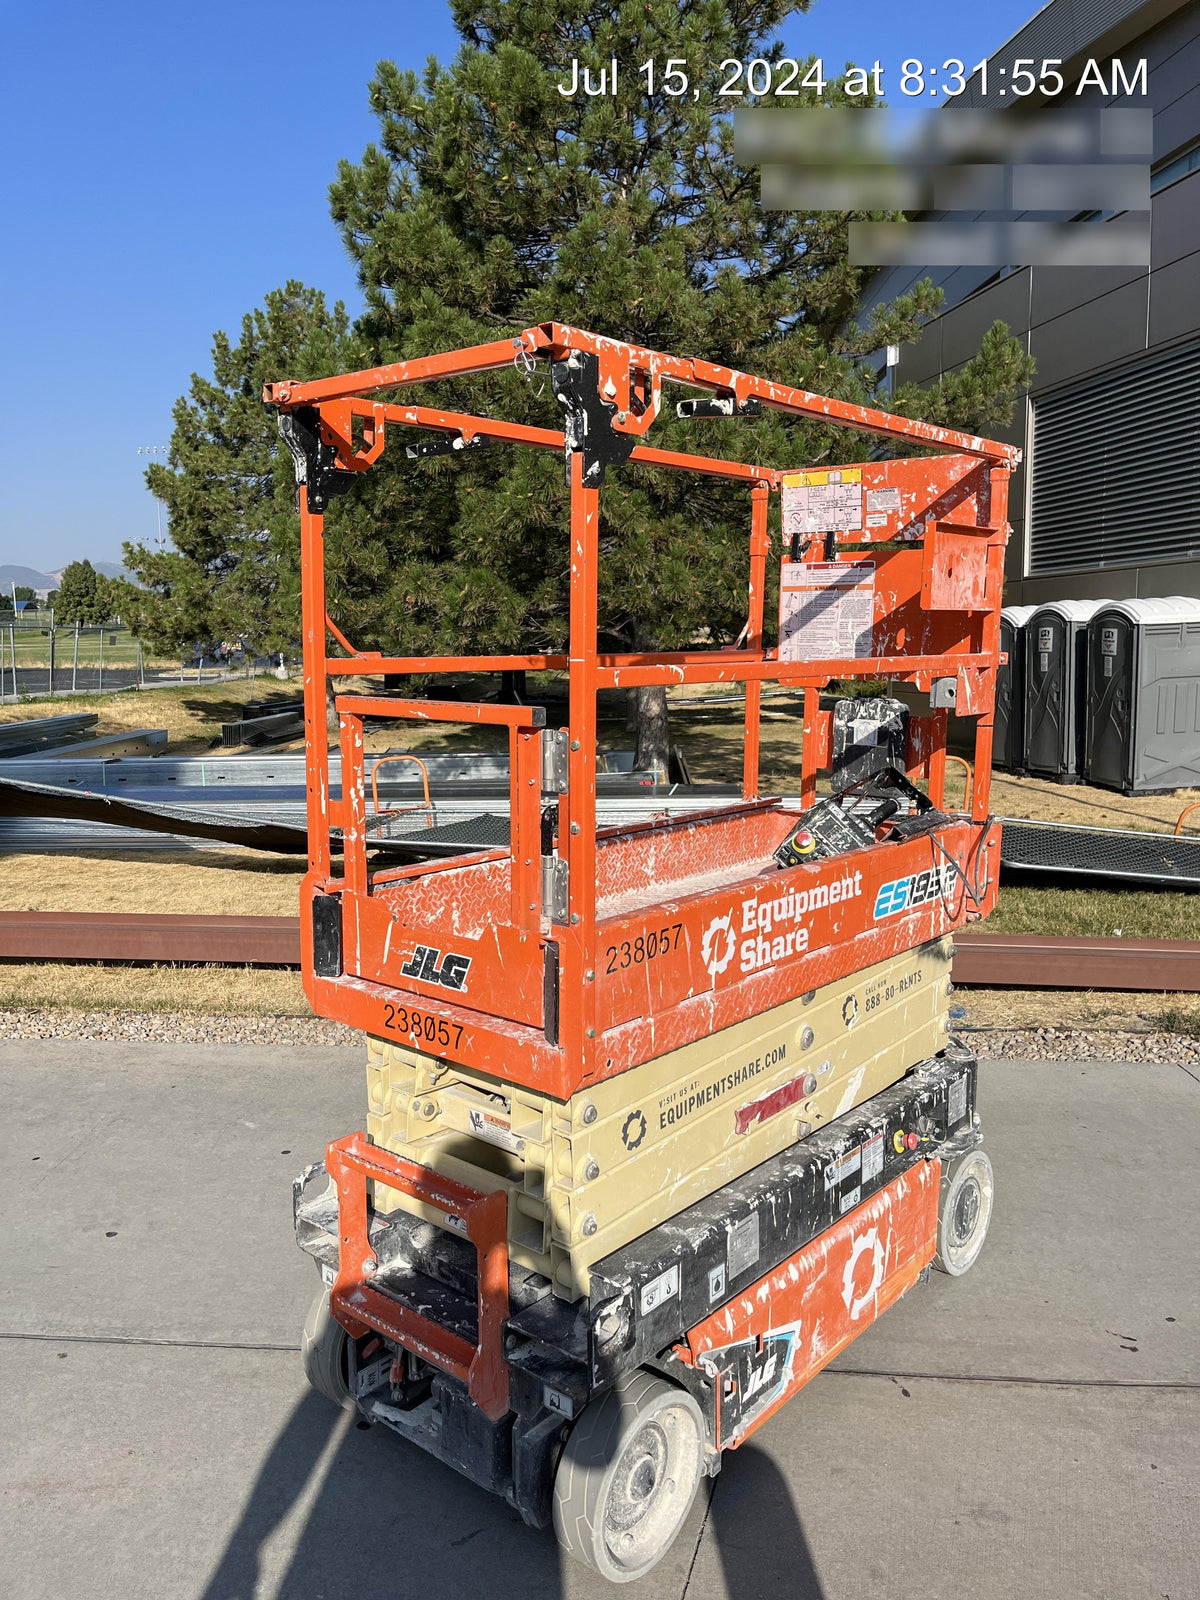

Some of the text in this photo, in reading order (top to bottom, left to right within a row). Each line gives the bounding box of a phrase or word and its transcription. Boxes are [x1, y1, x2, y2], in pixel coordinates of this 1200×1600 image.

[740, 869, 863, 934] Equipment
[400, 944, 472, 992] JLG
[605, 923, 683, 975] 238057
[739, 926, 809, 974] Share
[865, 979, 887, 995] CALL NOW
[865, 969, 922, 1012] 888-80-RENTS
[384, 1004, 464, 1050] 238057
[658, 1093, 676, 1108] VISIT
[679, 1087, 688, 1097] US
[659, 1044, 786, 1130] EQUIPMENTSHARE.COM
[741, 1352, 778, 1404] JLG
